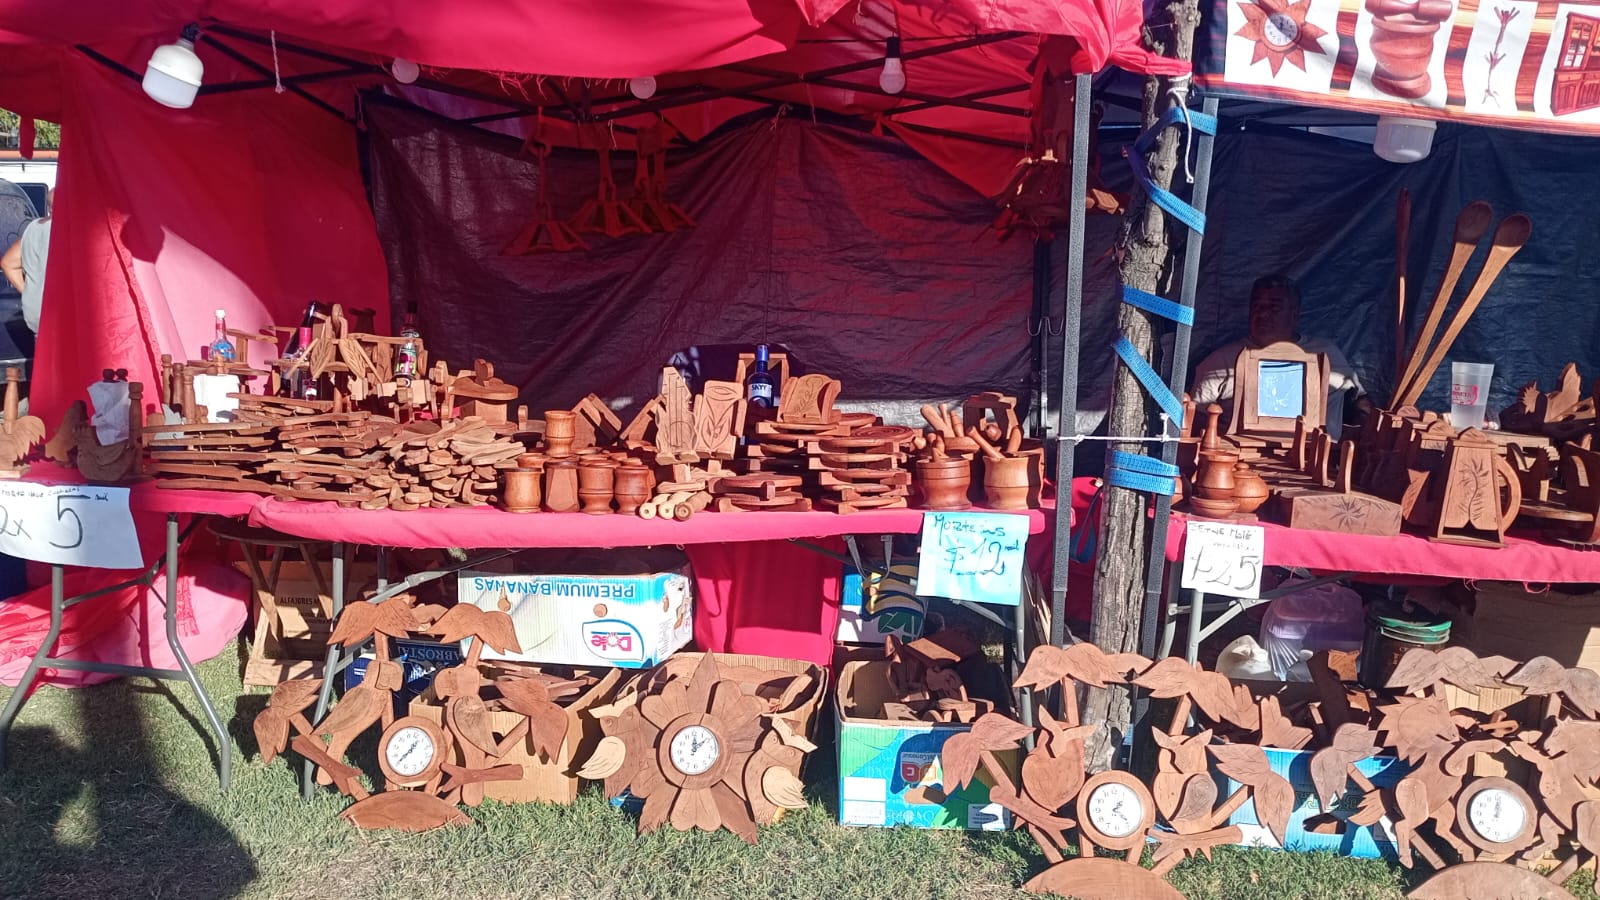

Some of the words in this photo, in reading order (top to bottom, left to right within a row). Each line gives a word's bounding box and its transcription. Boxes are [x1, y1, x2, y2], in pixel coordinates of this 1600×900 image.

[49, 494, 91, 549] 5
[474, 577, 552, 596] BANANAS
[556, 582, 635, 598] PREMIUM
[590, 634, 633, 652] Dole
